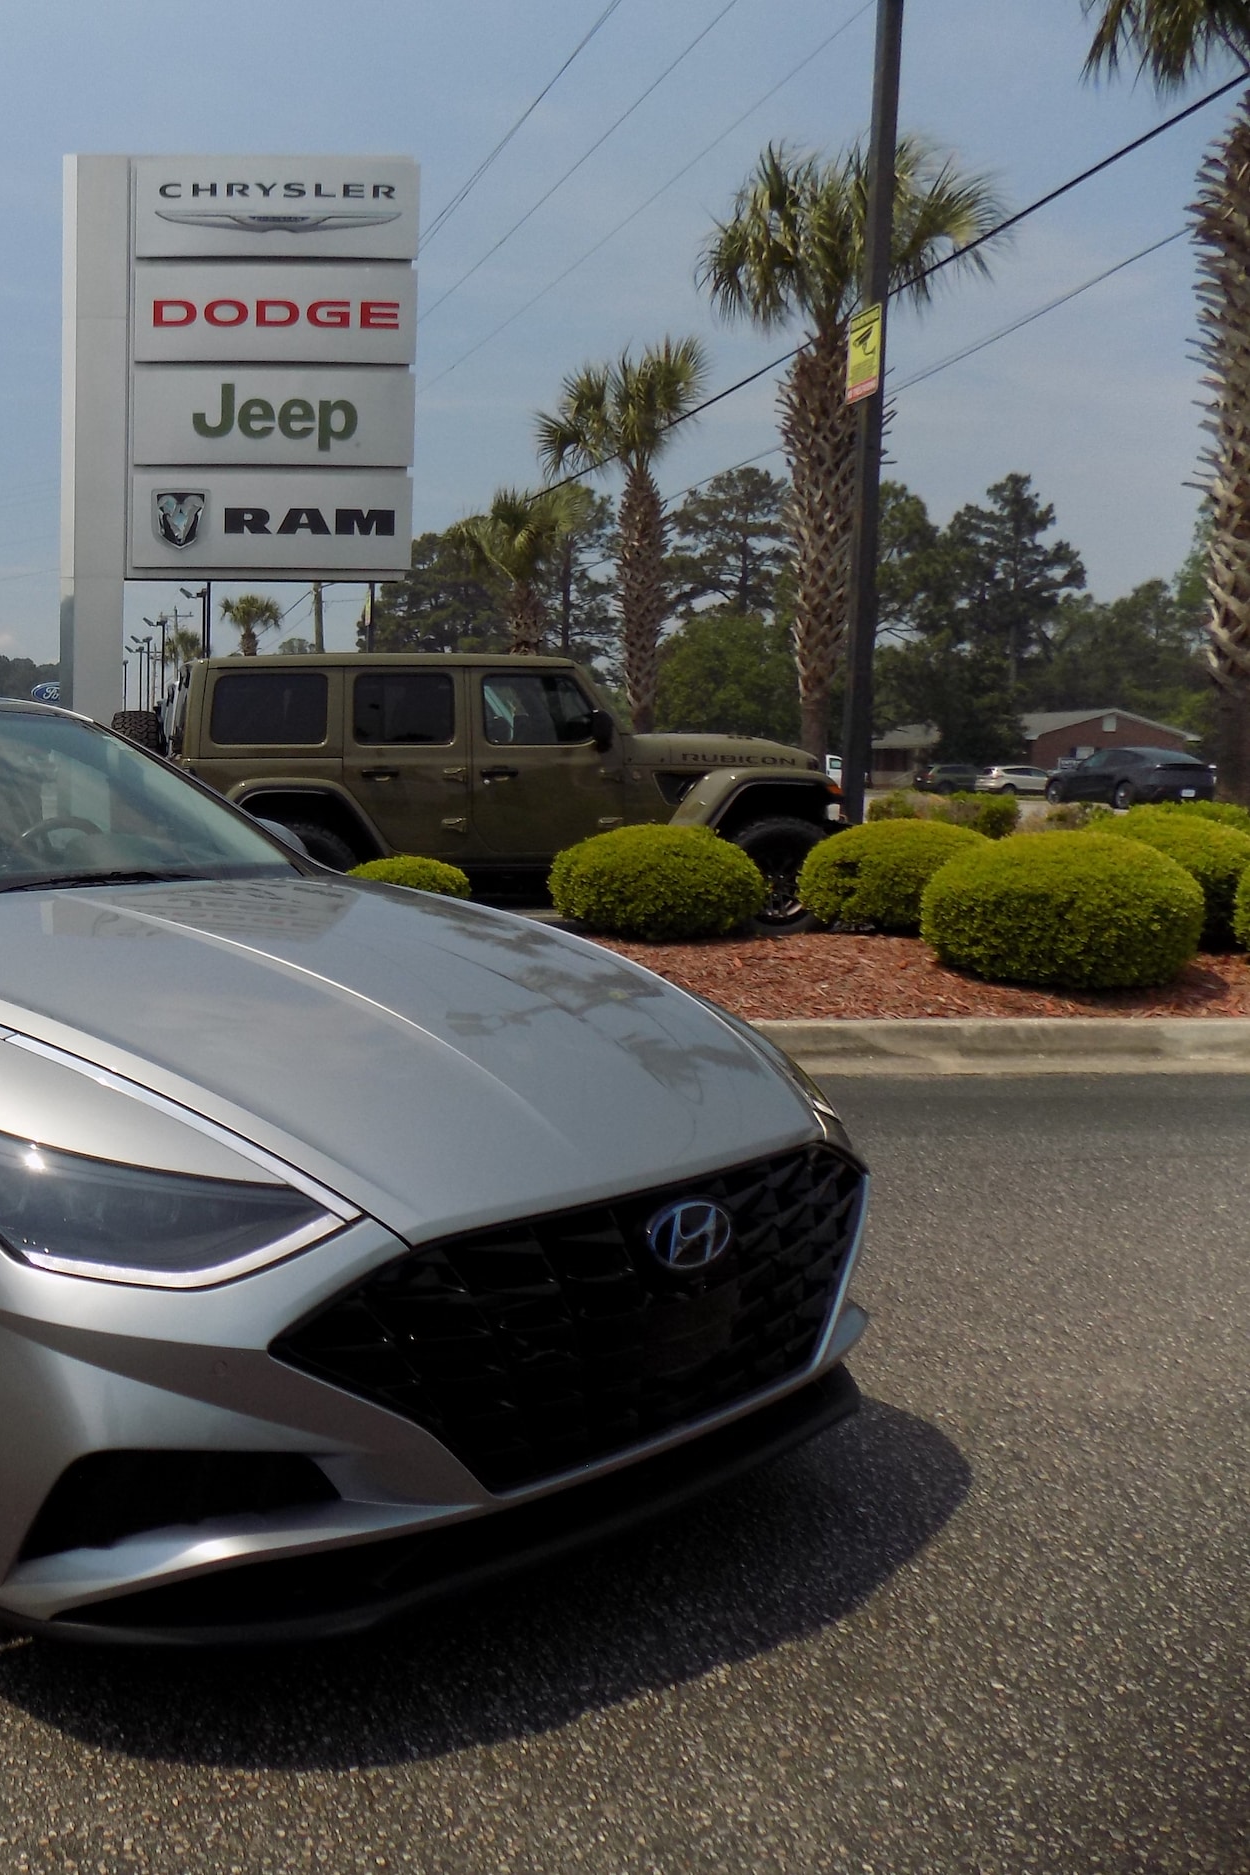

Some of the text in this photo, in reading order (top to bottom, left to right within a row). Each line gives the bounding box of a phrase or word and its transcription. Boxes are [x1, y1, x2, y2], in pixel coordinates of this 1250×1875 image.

[158, 182, 397, 200] CHRYSLER
[152, 299, 401, 330] DODGE
[191, 382, 359, 452] Jeep
[223, 507, 397, 537] RAM
[681, 752, 796, 767] RUBICON
